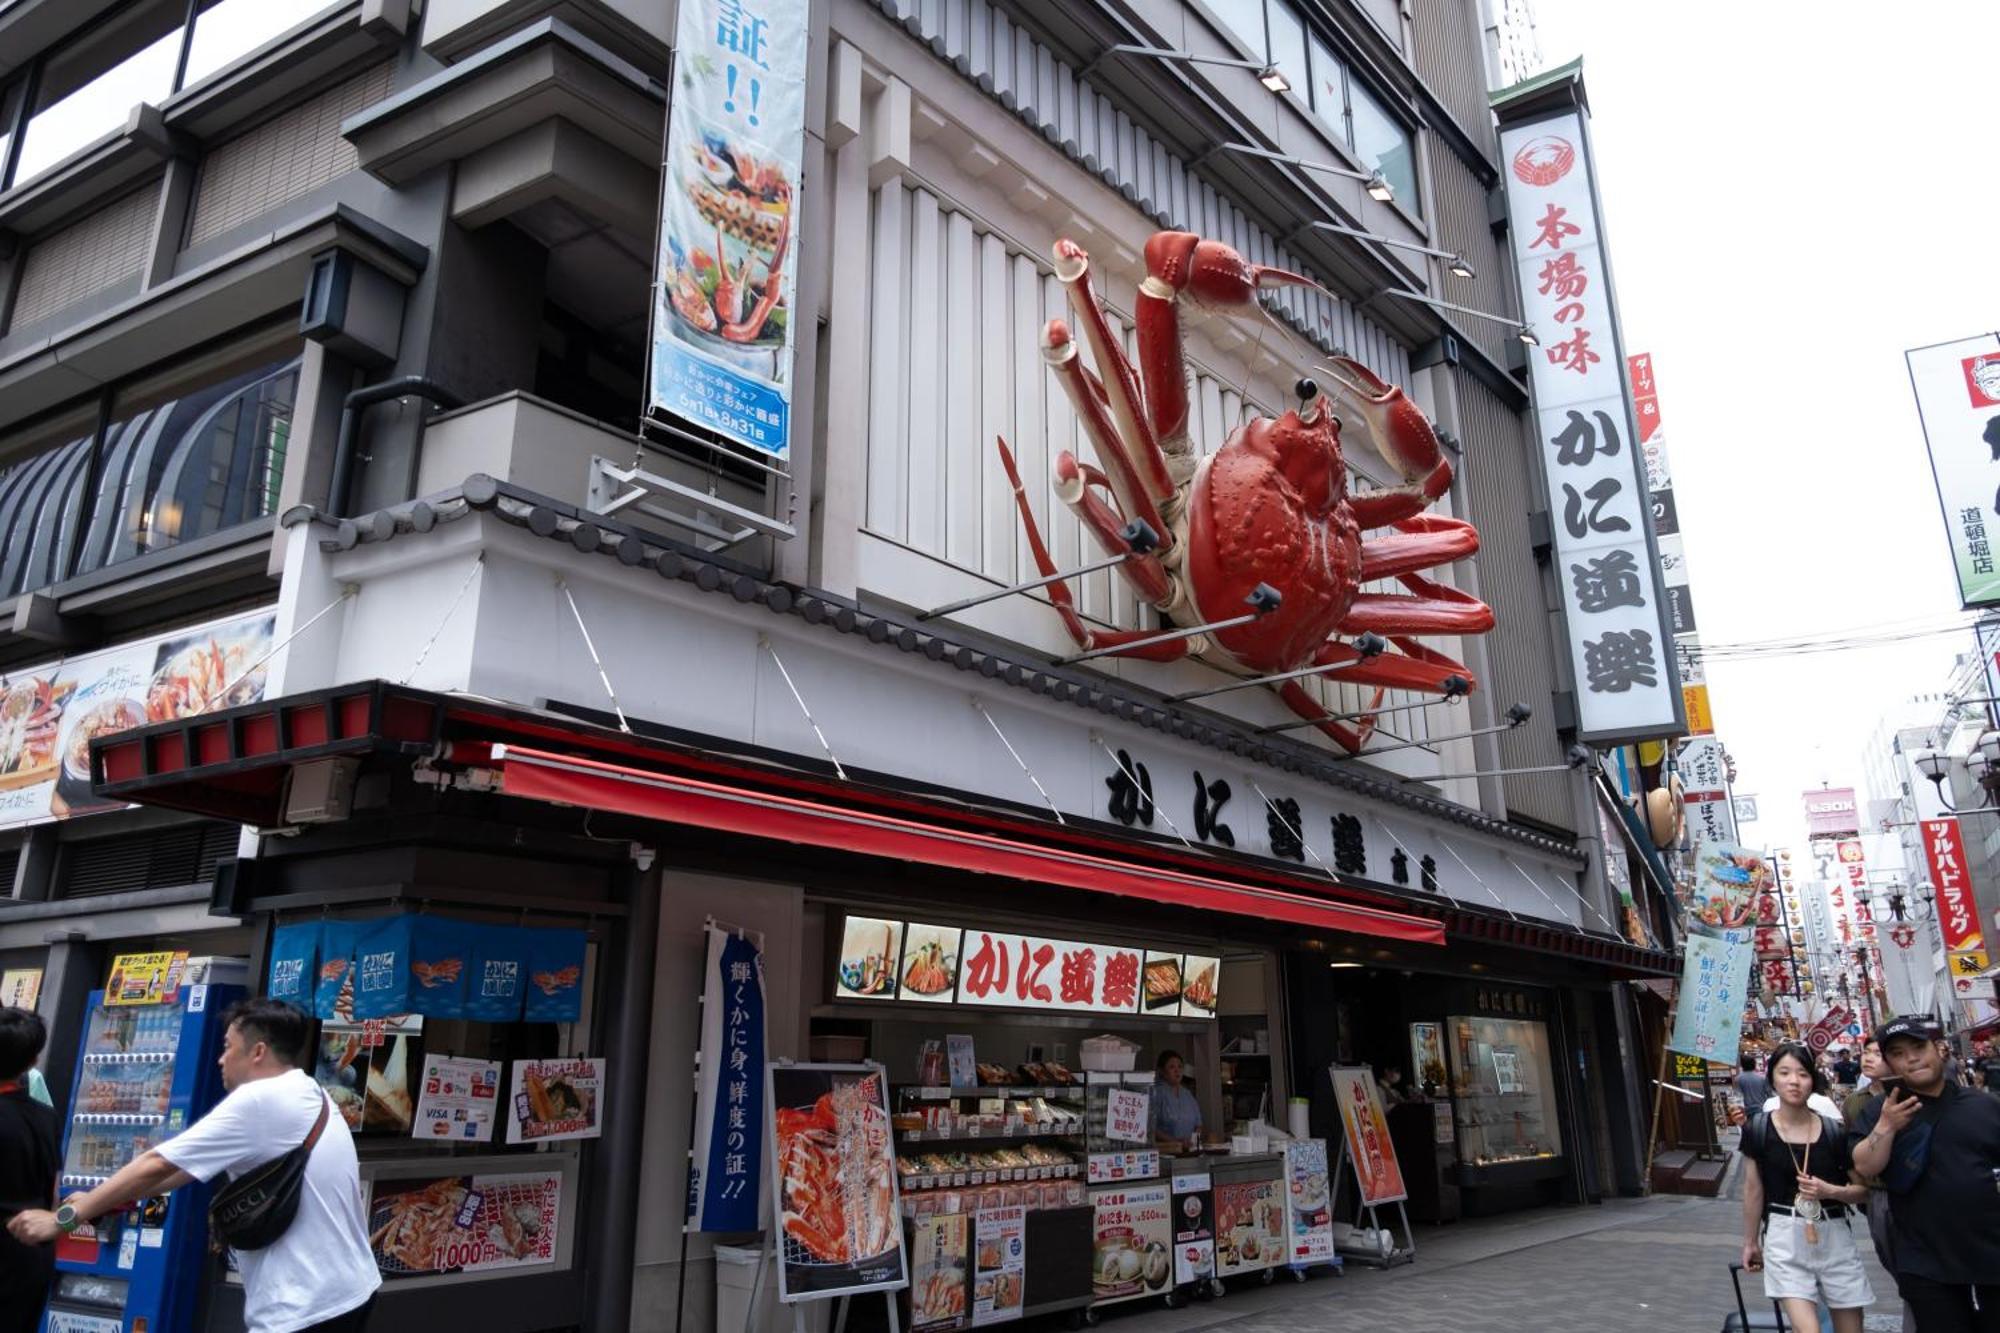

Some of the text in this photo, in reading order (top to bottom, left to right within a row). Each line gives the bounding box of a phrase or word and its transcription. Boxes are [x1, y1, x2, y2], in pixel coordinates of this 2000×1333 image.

[1528, 203, 1600, 374] 本場の味
[1960, 506, 1994, 575] 道頓堀店
[1929, 822, 1970, 934] ツルハドラッグ
[427, 1109, 448, 1119] VISA
[434, 1243, 496, 1273] 1,000円
